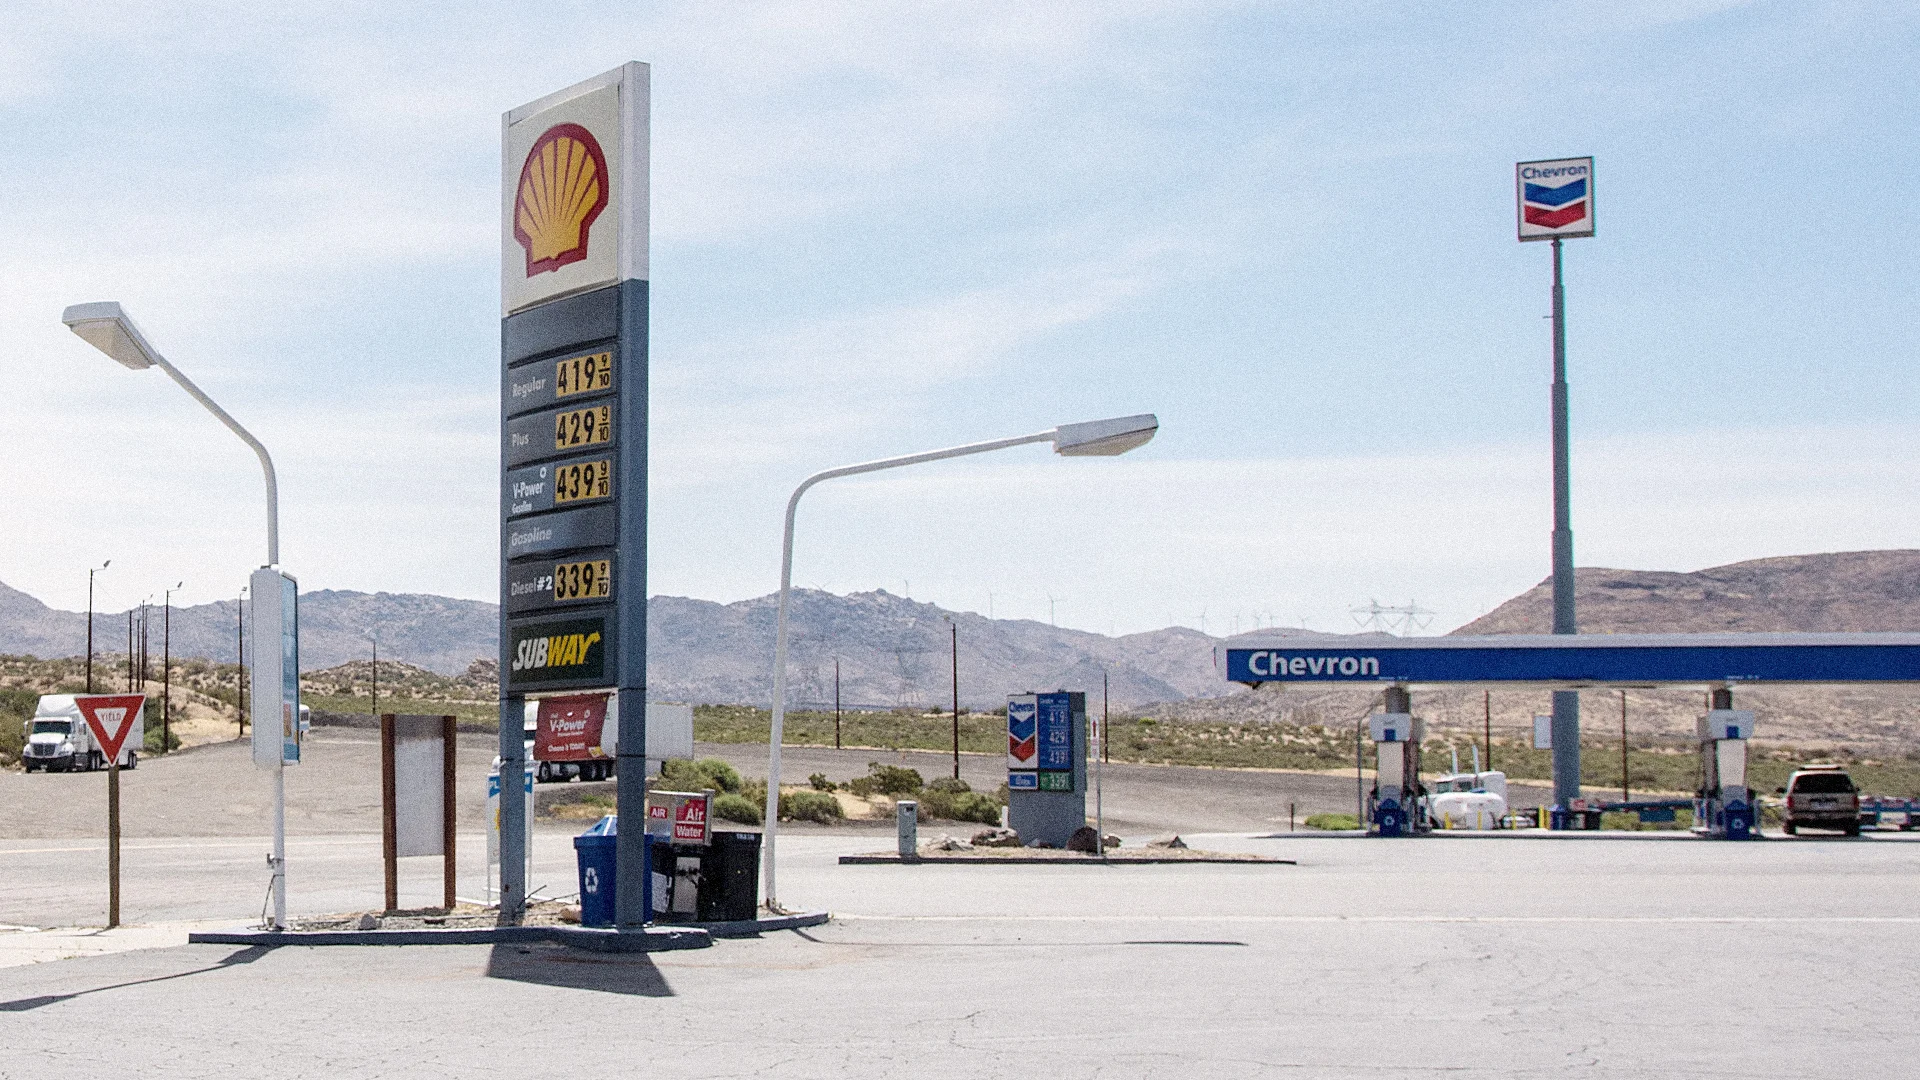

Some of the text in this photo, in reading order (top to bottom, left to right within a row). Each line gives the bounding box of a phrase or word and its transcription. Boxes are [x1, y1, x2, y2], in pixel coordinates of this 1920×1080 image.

[1522, 165, 1587, 179] Chevron
[558, 357, 595, 393] 419
[512, 377, 546, 397] Regular
[557, 411, 595, 445] 429
[512, 433, 529, 447] Plus
[513, 481, 545, 499] V-Power
[557, 464, 594, 499] 439
[511, 527, 552, 546] Gasoline
[556, 563, 594, 598] 339
[512, 632, 601, 671] SUBWAY
[1248, 651, 1380, 676] Chevron
[101, 711, 121, 721] YIELD
[549, 718, 587, 732] V-Power
[651, 808, 666, 817] AIR
[685, 808, 704, 821] Air
[676, 825, 703, 837] Water
